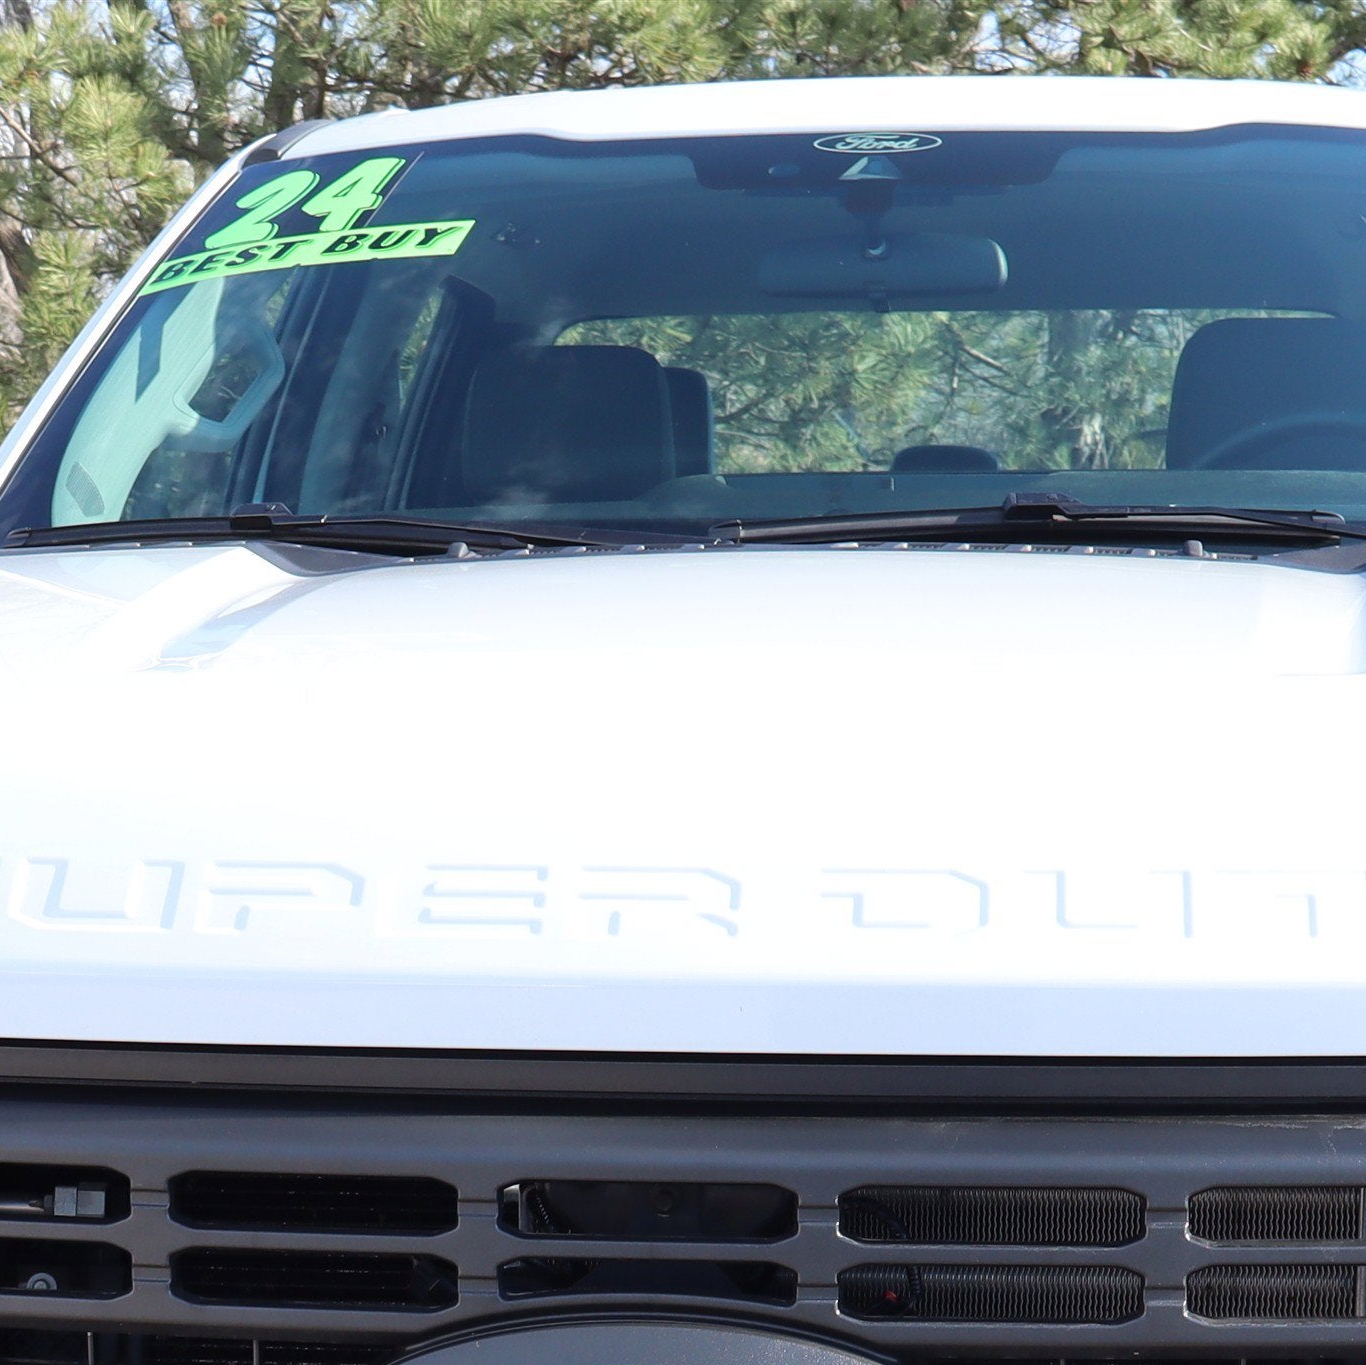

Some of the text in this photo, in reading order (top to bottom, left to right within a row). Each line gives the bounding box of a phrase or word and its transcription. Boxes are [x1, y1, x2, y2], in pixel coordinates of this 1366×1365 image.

[835, 134, 919, 150] Ford
[204, 156, 406, 250] 24
[150, 226, 463, 284] BEST BUY
